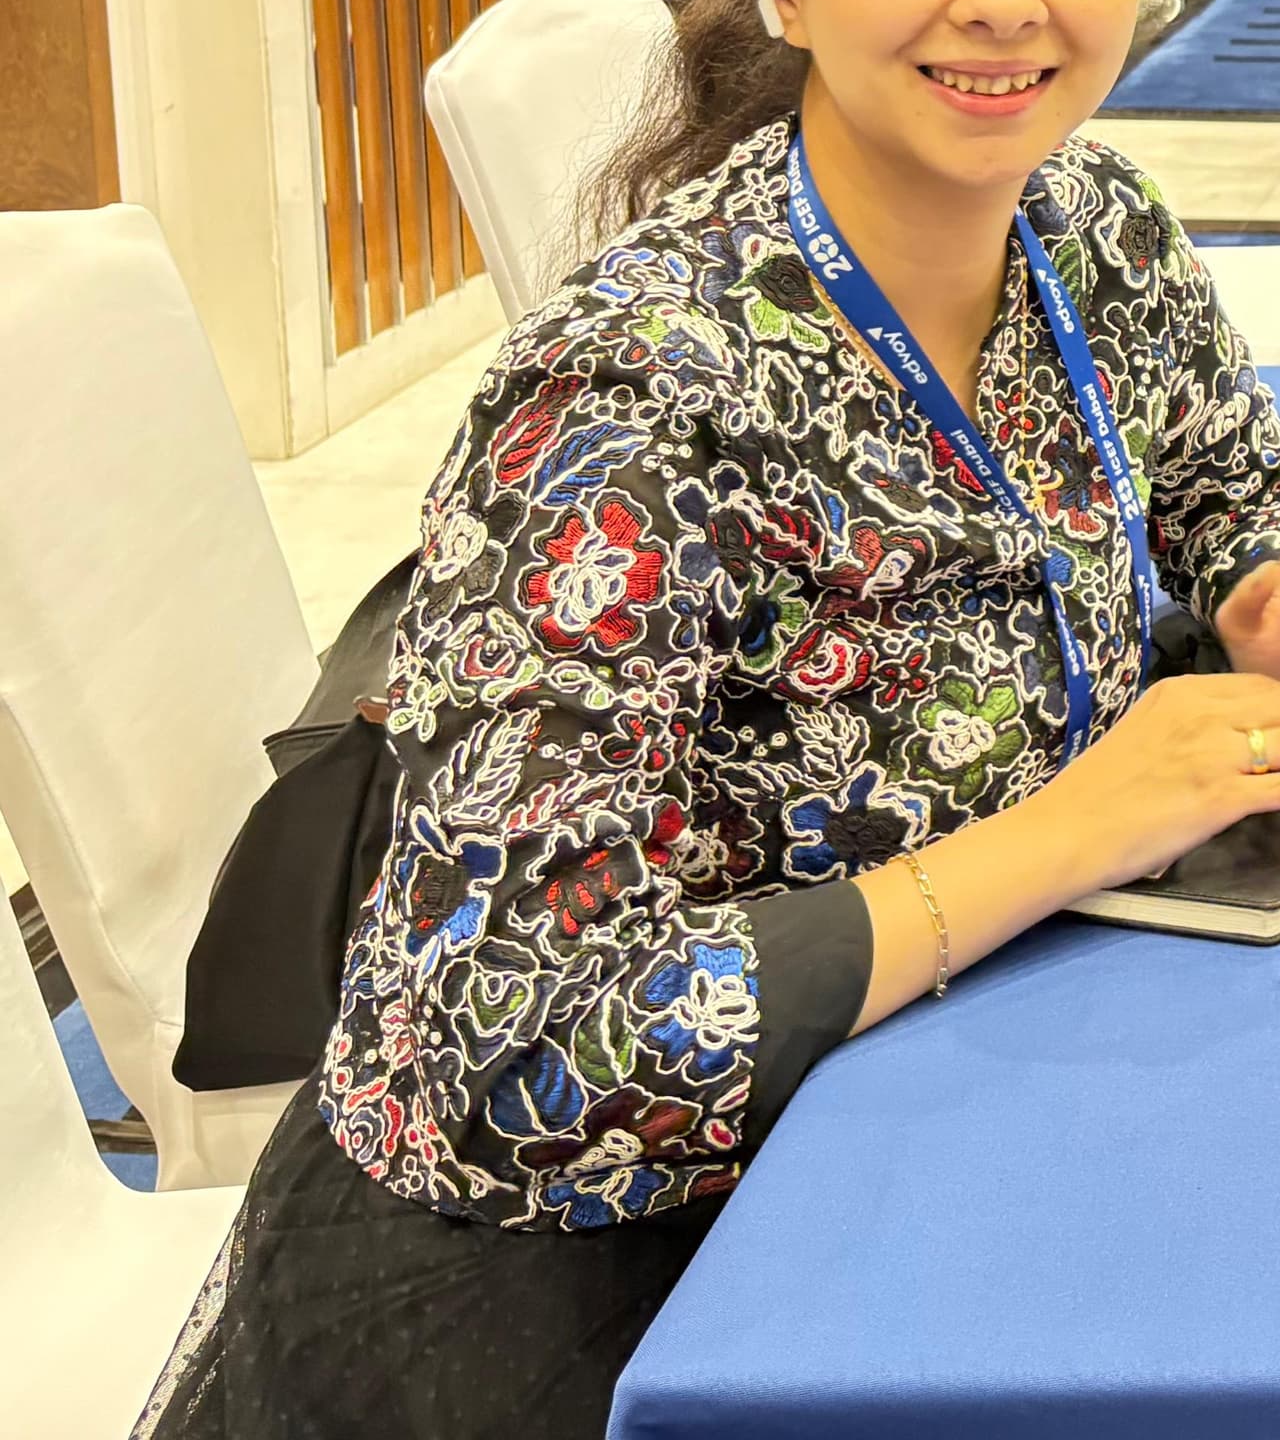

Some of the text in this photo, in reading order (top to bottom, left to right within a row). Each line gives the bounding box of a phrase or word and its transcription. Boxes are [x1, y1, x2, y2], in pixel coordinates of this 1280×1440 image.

[792, 196, 822, 237] ICEF
[1046, 277, 1076, 334] edvoy
[884, 331, 929, 385] edvoy
[1081, 383, 1110, 438] Dubai
[950, 428, 992, 483] Dubai
[1102, 438, 1123, 476] ICEF
